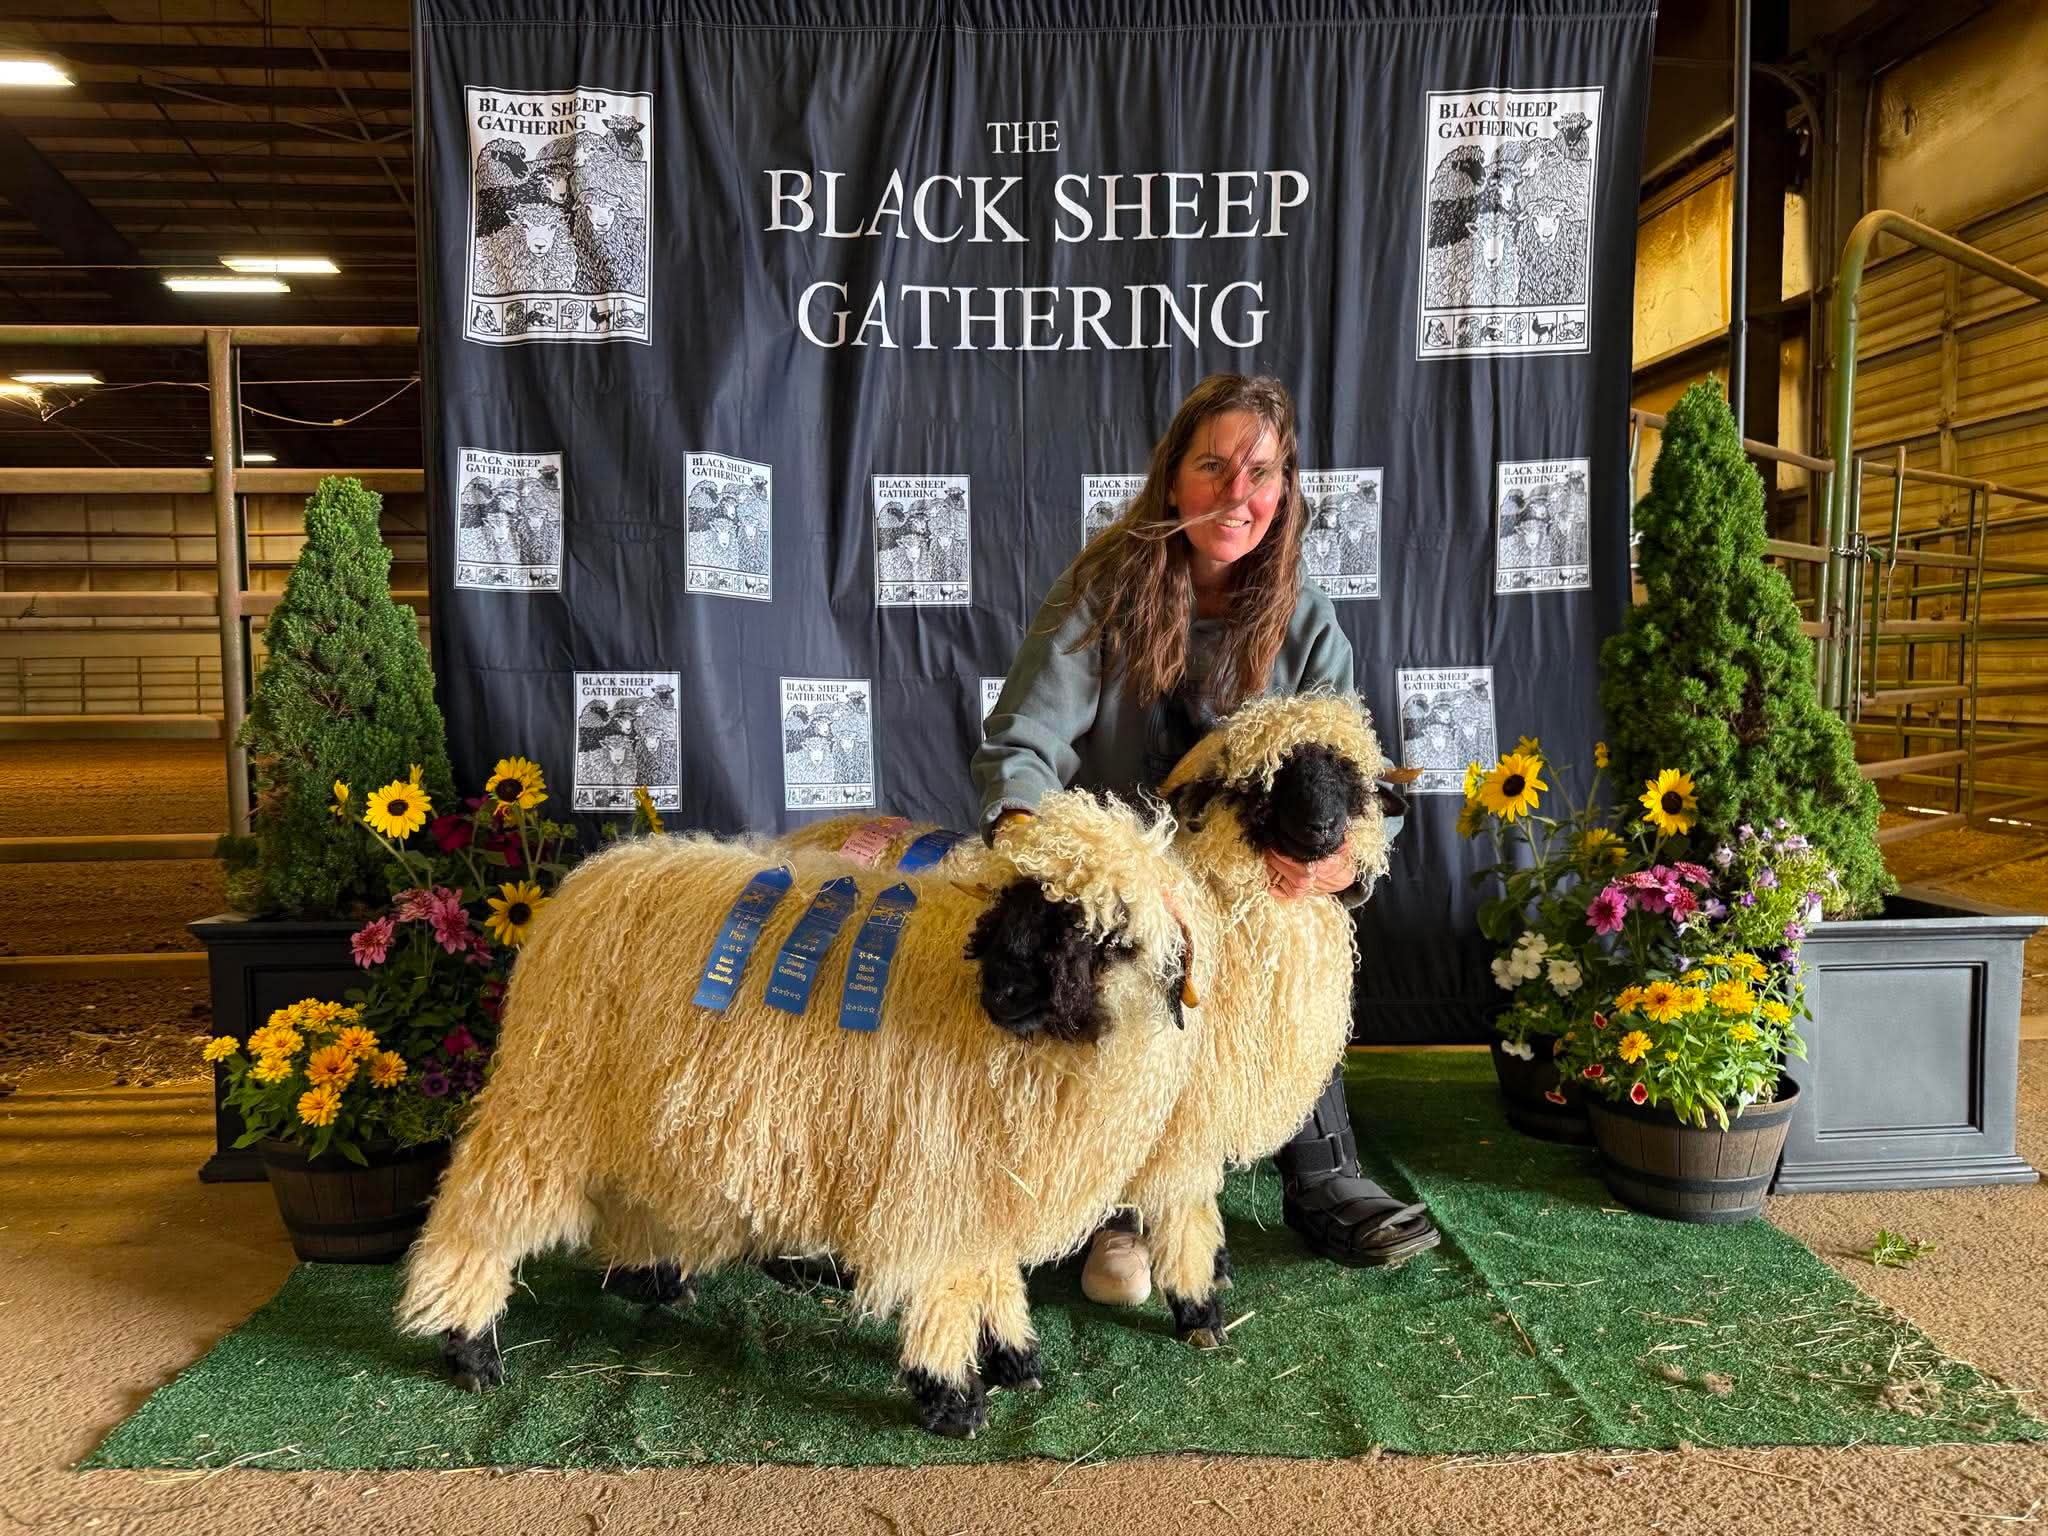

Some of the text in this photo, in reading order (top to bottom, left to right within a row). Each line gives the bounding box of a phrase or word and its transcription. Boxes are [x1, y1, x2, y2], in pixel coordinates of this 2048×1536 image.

[479, 97, 607, 117] BLACK SHEEP
[1439, 100, 1558, 119] BLACK SHEEP
[478, 114, 586, 136] GATHERING
[1438, 120, 1538, 139] GATHERING
[986, 120, 1061, 153] THE
[763, 168, 1310, 243] BLACK SHEEP
[798, 279, 1270, 351] GATHERING
[466, 453, 541, 468] BLACK SHEEP
[692, 457, 753, 475] BLACK SHEEP
[466, 464, 531, 477] GATHERING
[1504, 464, 1567, 475] BLACK SHEEP
[692, 467, 745, 484] GATHERING
[1301, 474, 1359, 483] LACK SHEEP
[1503, 474, 1558, 484] GATHERING
[879, 479, 946, 489] BLACK SHEEP
[1089, 479, 1146, 488] BLACK SHE
[879, 488, 937, 498] GATHERING
[582, 677, 653, 687] BLACK SHEEP
[1403, 672, 1469, 682] BLACK SHEEP
[786, 682, 848, 693] BLACK SHEEP
[1403, 681, 1461, 691] GATHERING
[582, 687, 644, 697] GATHERING
[786, 692, 839, 702] GATHERING
